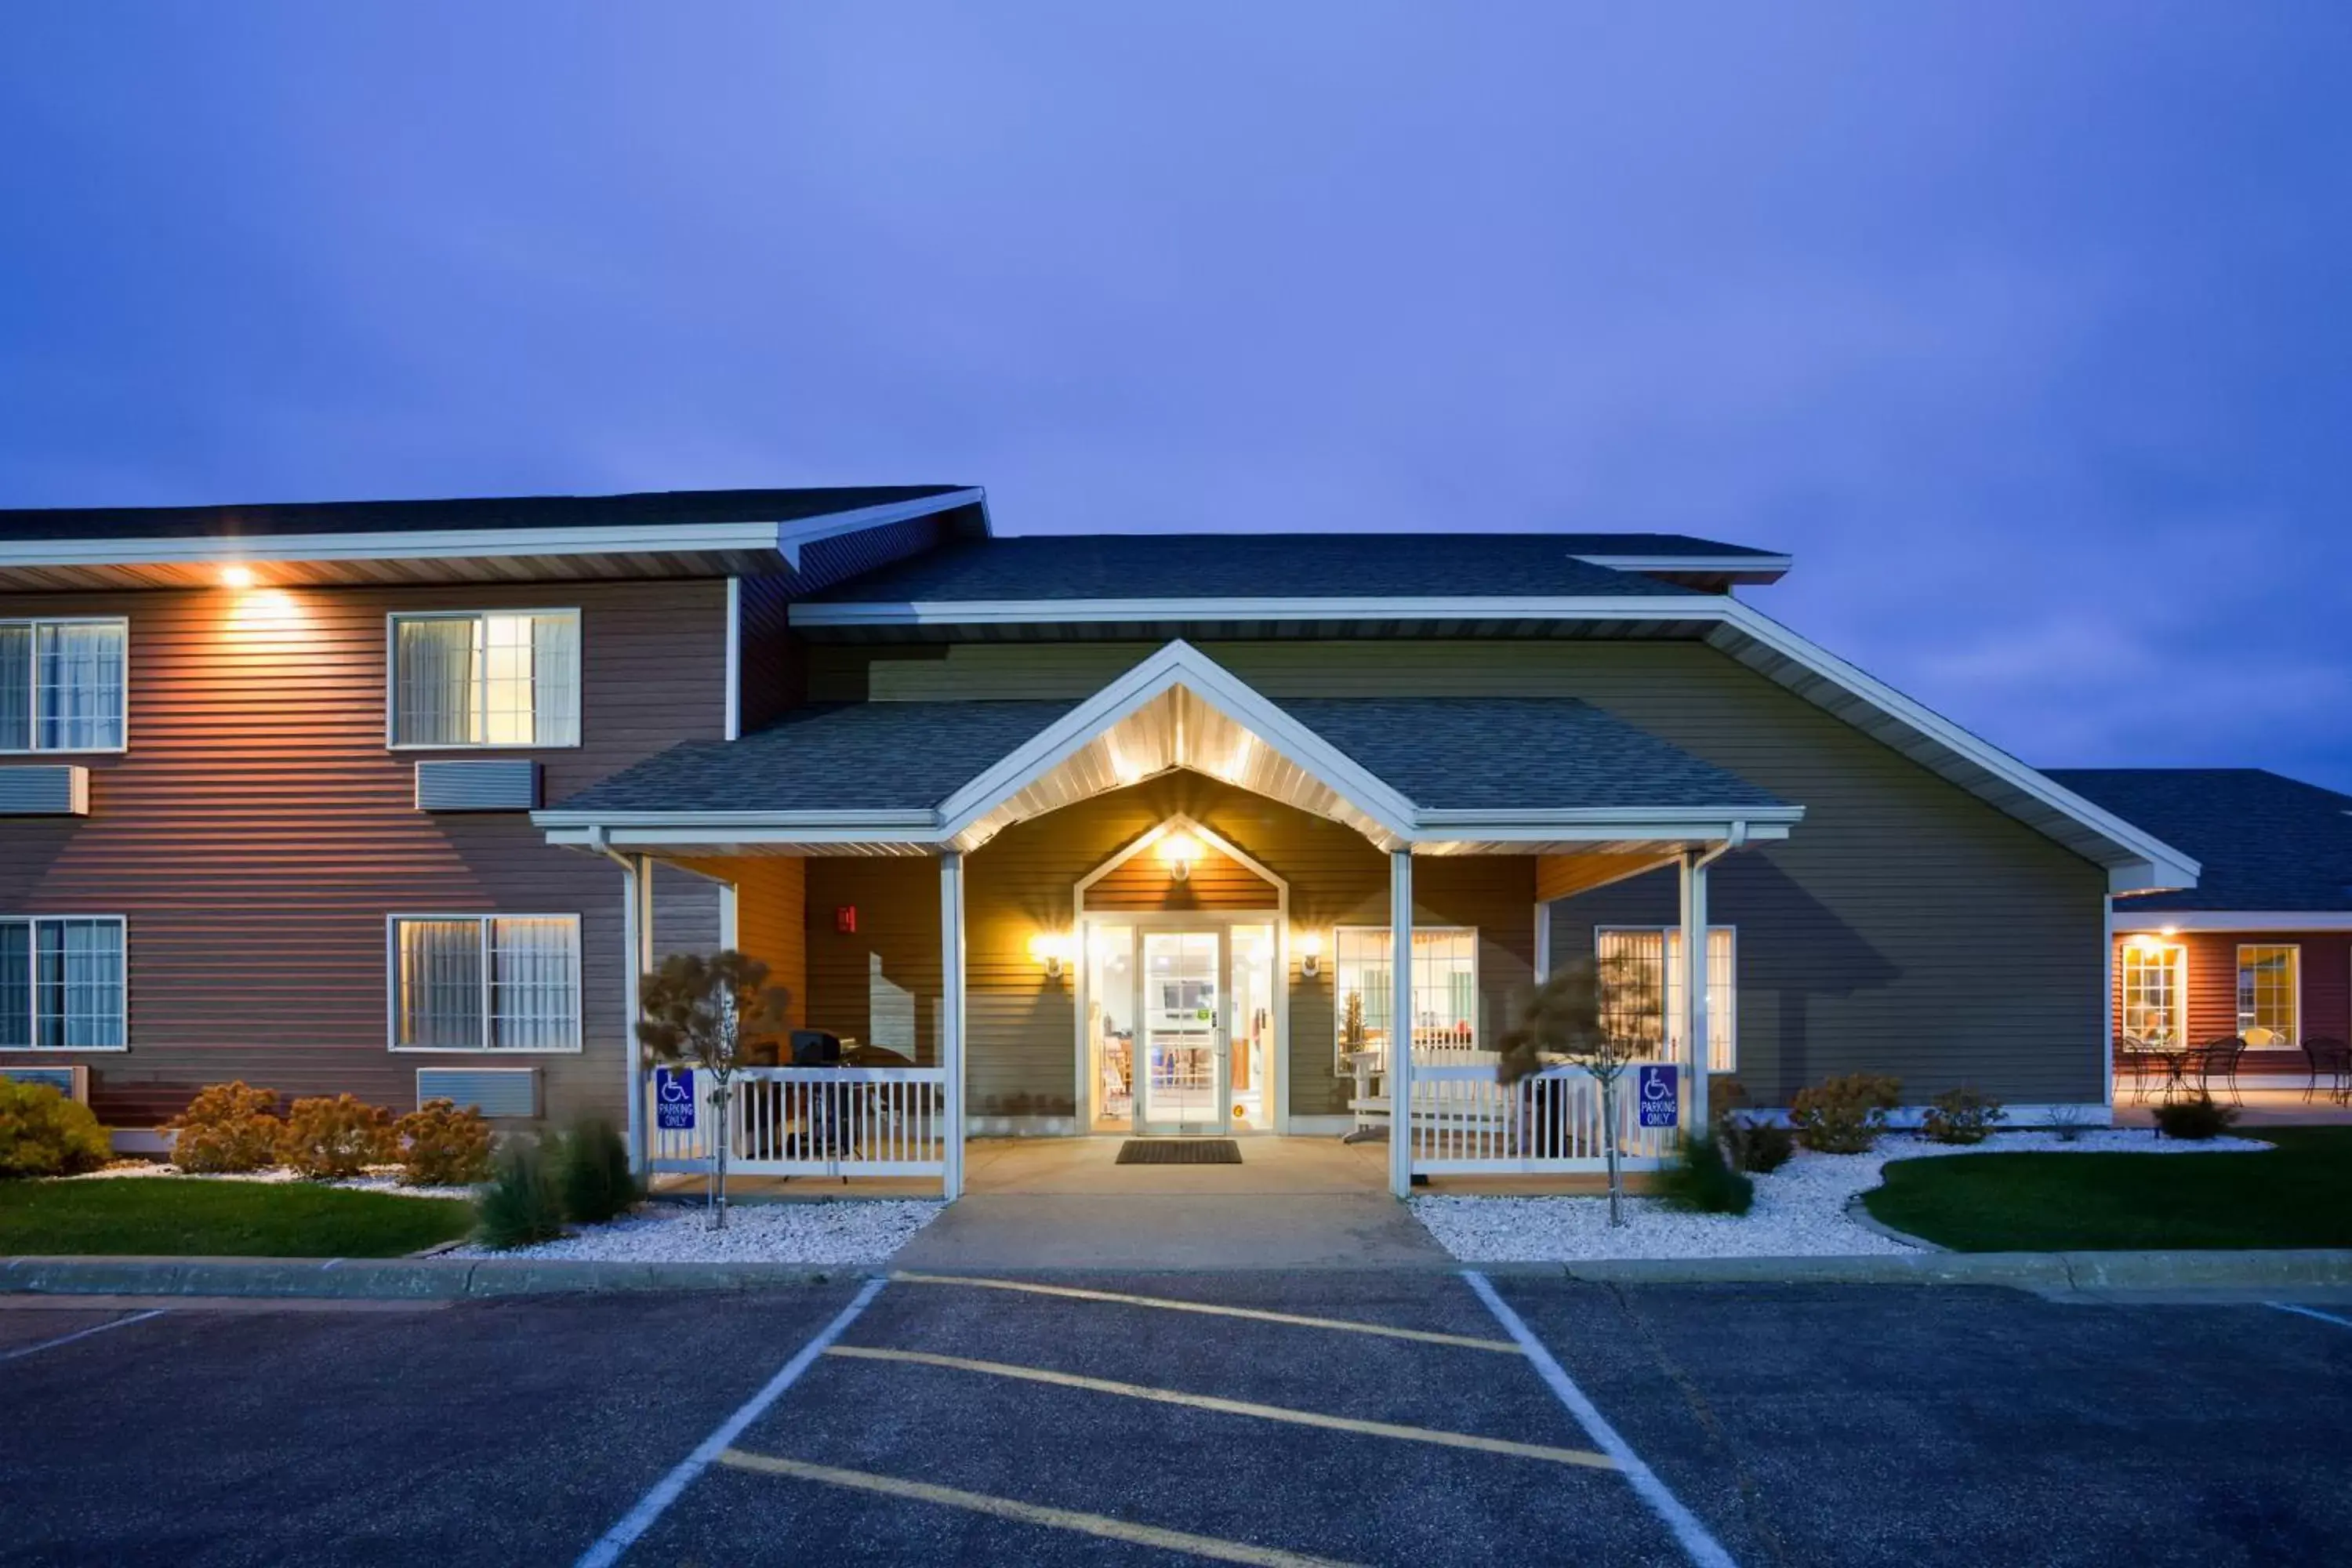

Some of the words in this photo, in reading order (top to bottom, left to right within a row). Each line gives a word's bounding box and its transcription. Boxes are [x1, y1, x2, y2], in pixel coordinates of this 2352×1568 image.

[659, 1103, 693, 1115] PARKING
[1641, 1101, 1675, 1112] PARKING
[665, 1115, 687, 1126] ONLY
[1647, 1113, 1670, 1124] ONLY
